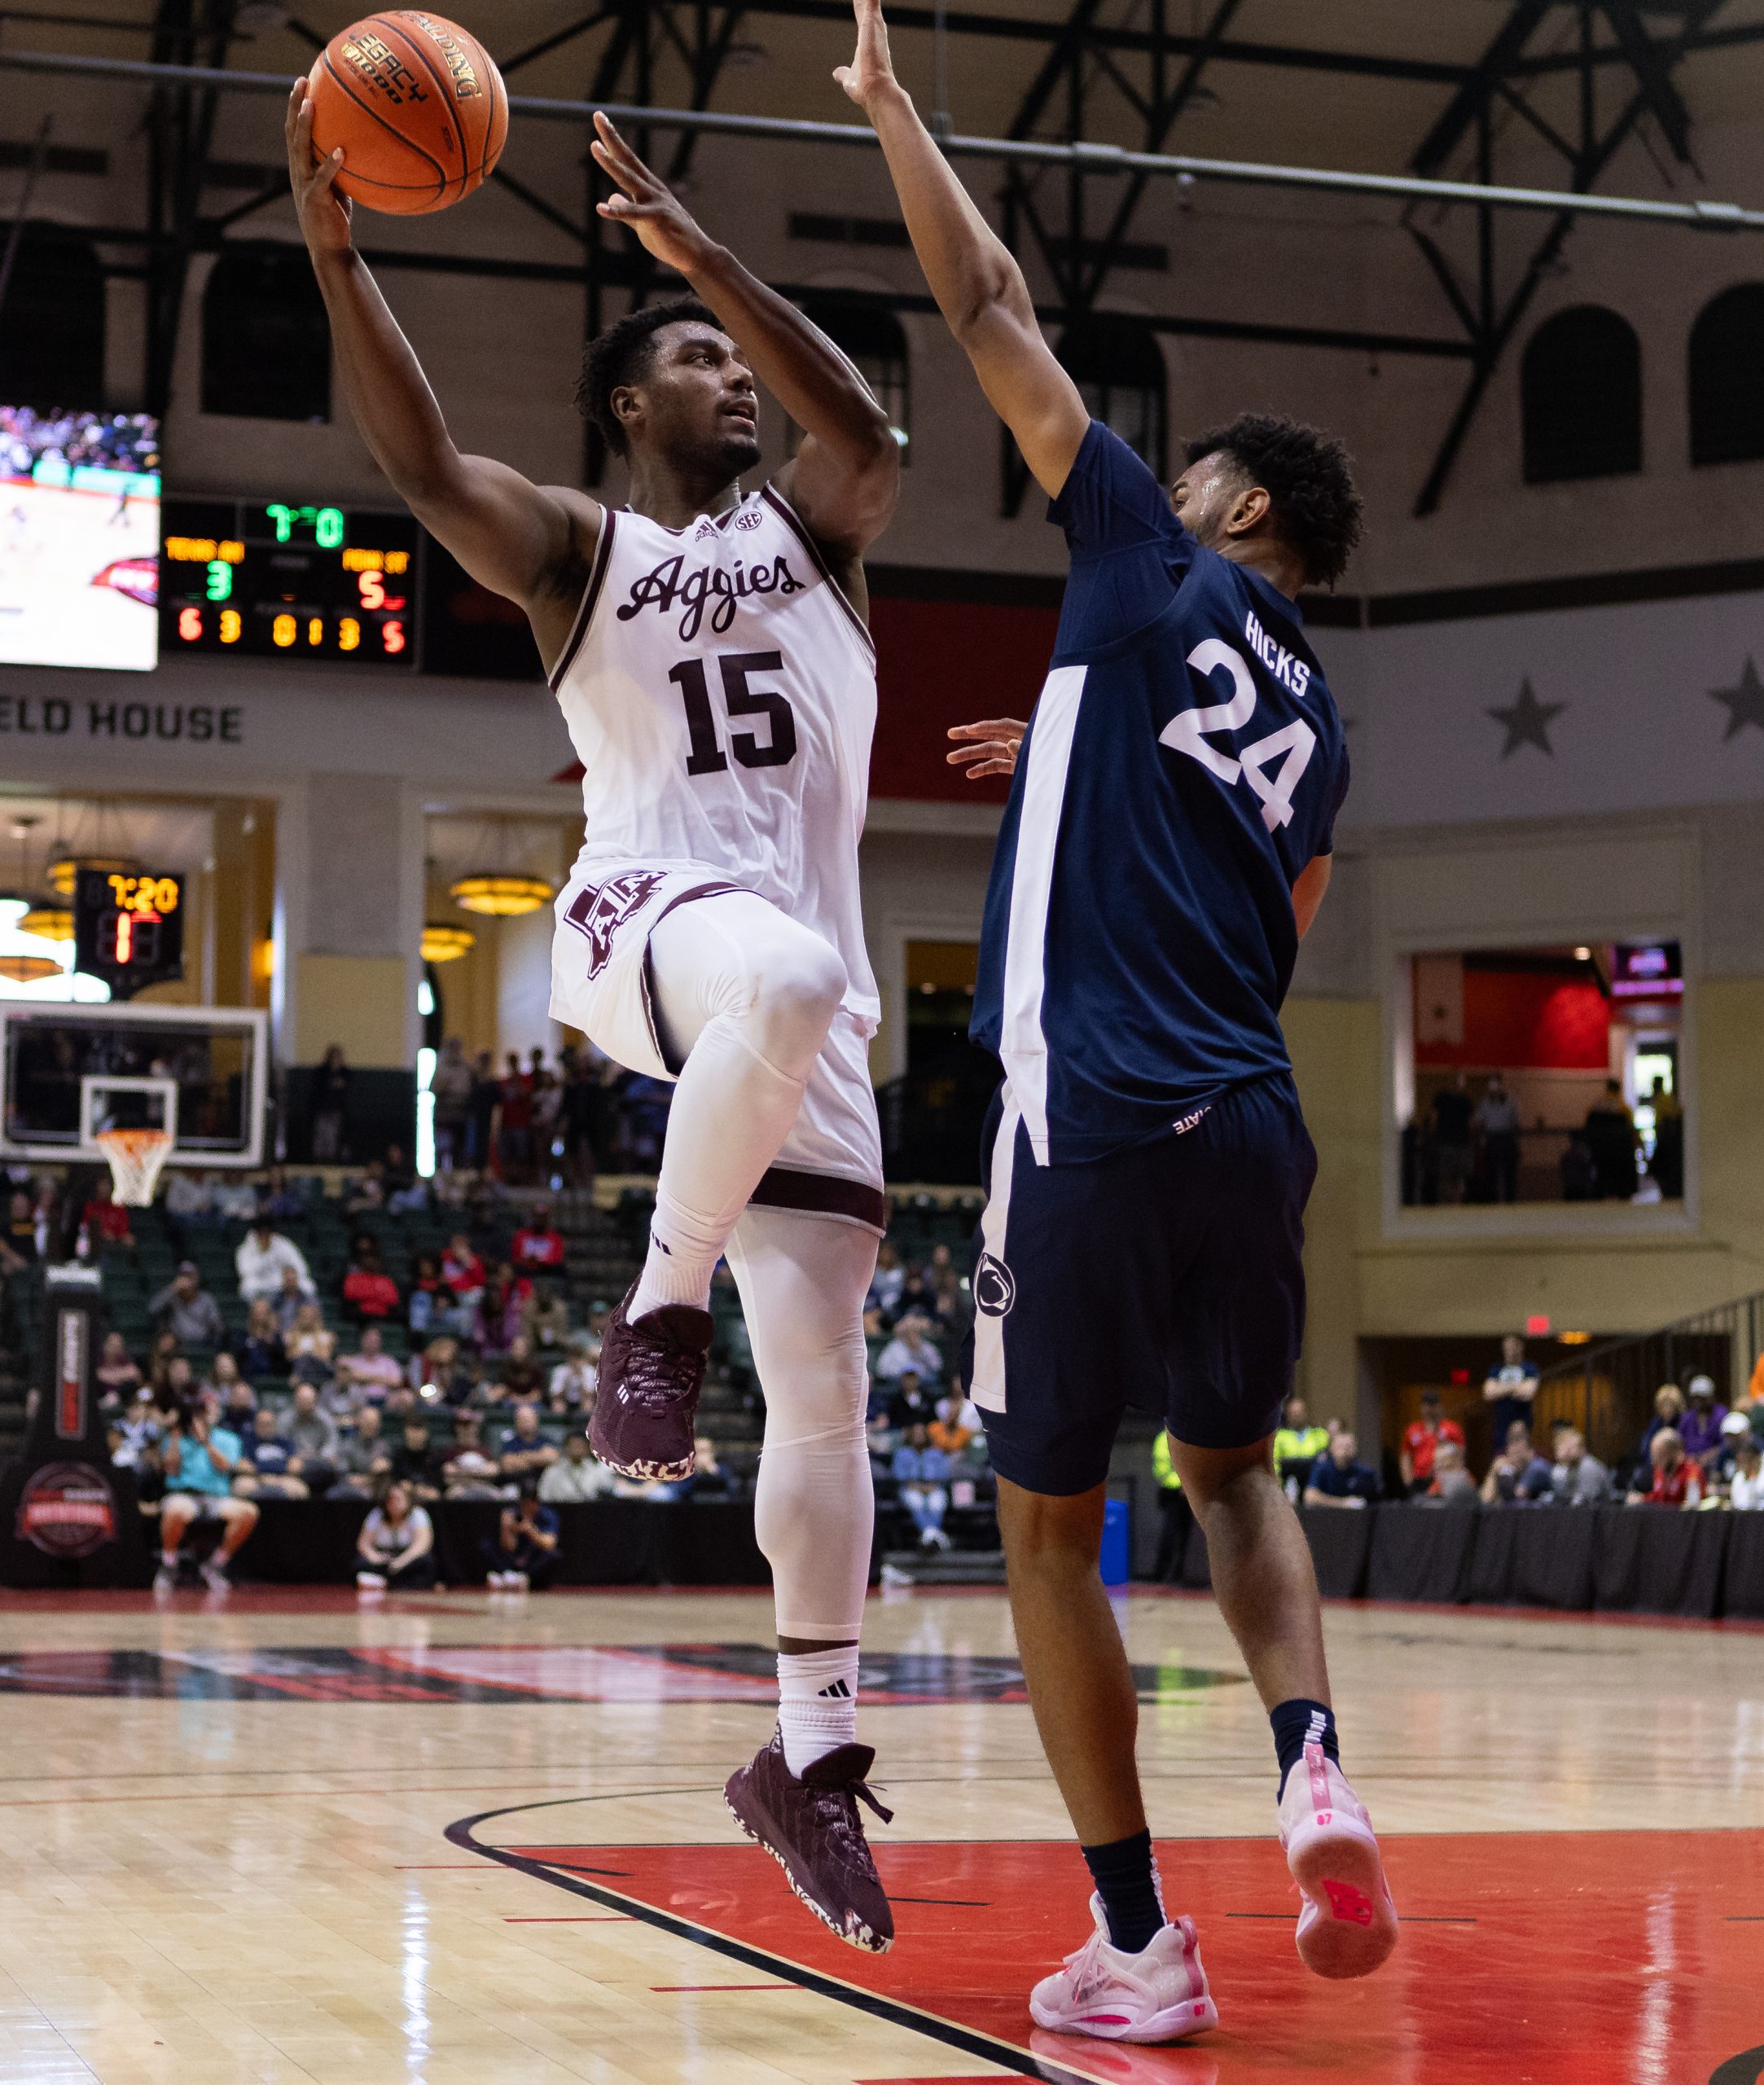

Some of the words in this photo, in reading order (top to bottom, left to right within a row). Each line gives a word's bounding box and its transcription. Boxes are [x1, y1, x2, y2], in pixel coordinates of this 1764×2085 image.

[397, 11, 482, 100] ALDING
[266, 504, 344, 548] 7:0
[695, 530, 720, 542] adida
[738, 513, 760, 529] SEC
[617, 555, 806, 642] Aggies
[1245, 610, 1310, 697] HICKS
[88, 699, 244, 744] HOUSE
[668, 650, 797, 776] 15
[1158, 638, 1317, 833] 24
[108, 874, 178, 914] 7:20
